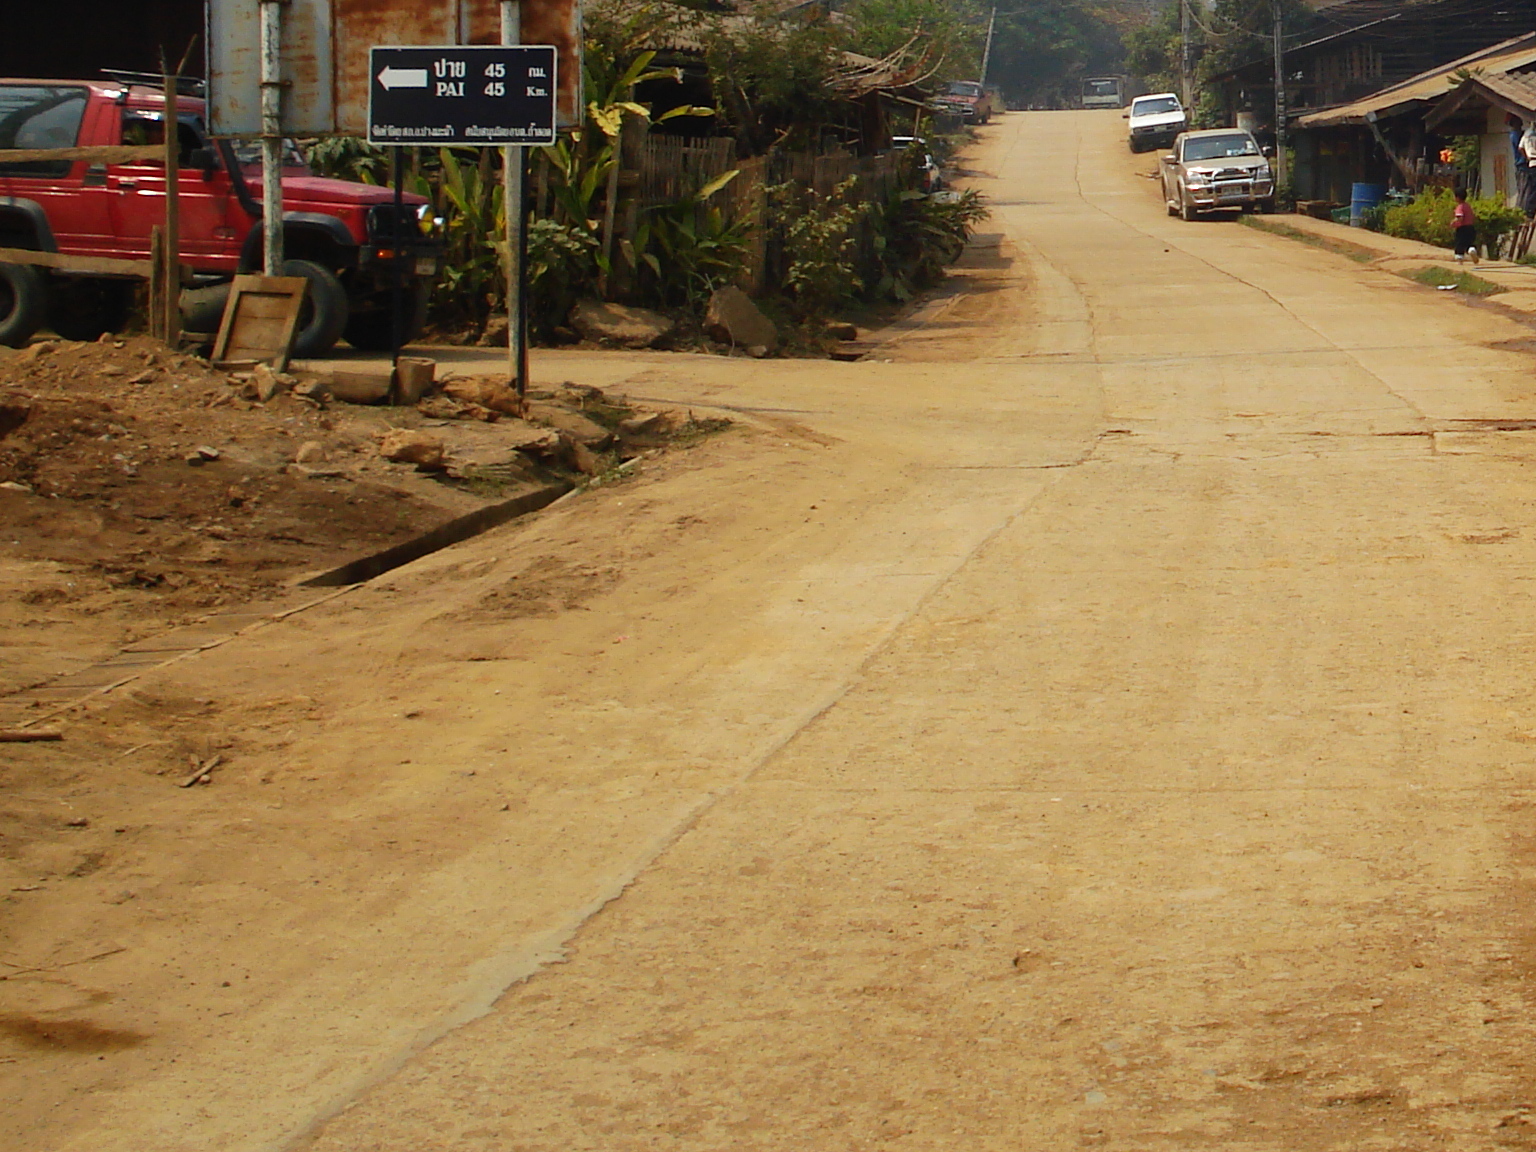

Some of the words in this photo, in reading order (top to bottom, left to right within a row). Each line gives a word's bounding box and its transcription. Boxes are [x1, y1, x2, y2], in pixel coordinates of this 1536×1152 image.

[434, 58, 466, 78] ปาย
[484, 63, 506, 78] 45
[528, 67, 547, 78] กม.
[436, 82, 464, 97] PAI
[484, 82, 506, 97] 45
[526, 86, 549, 97] Km.
